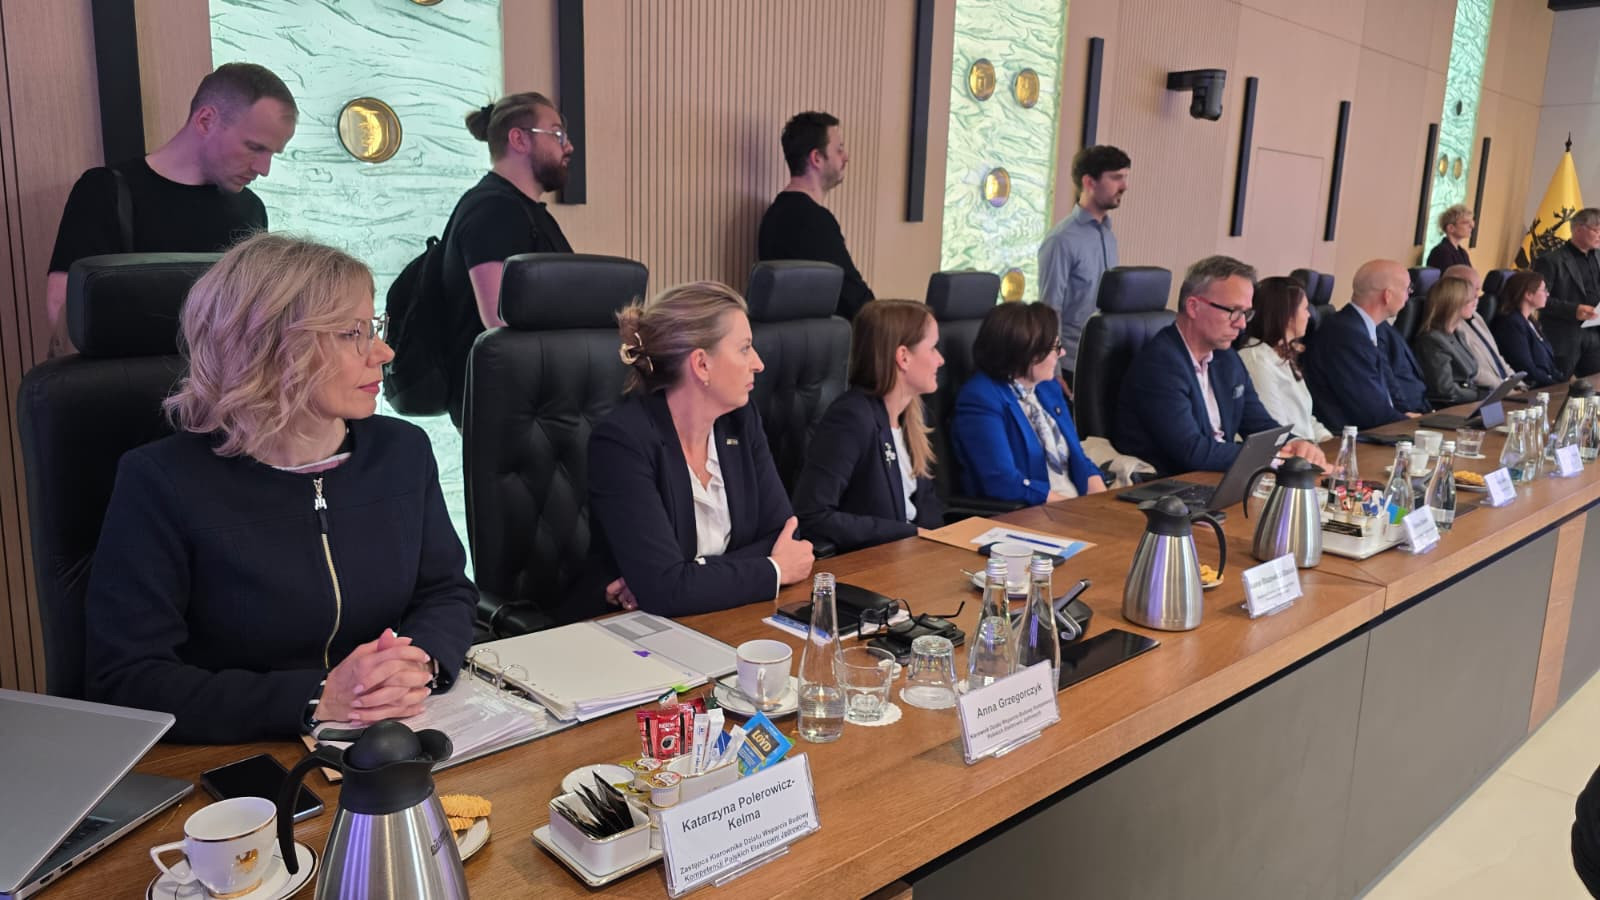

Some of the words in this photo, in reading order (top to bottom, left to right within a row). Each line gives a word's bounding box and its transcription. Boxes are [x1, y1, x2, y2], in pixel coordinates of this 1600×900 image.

[977, 703, 997, 718] Anna
[998, 683, 1042, 708] Grzegorczyk
[682, 803, 736, 832] Katarzyna
[738, 779, 795, 808] Polerowicz-
[728, 810, 760, 830] Kelma
